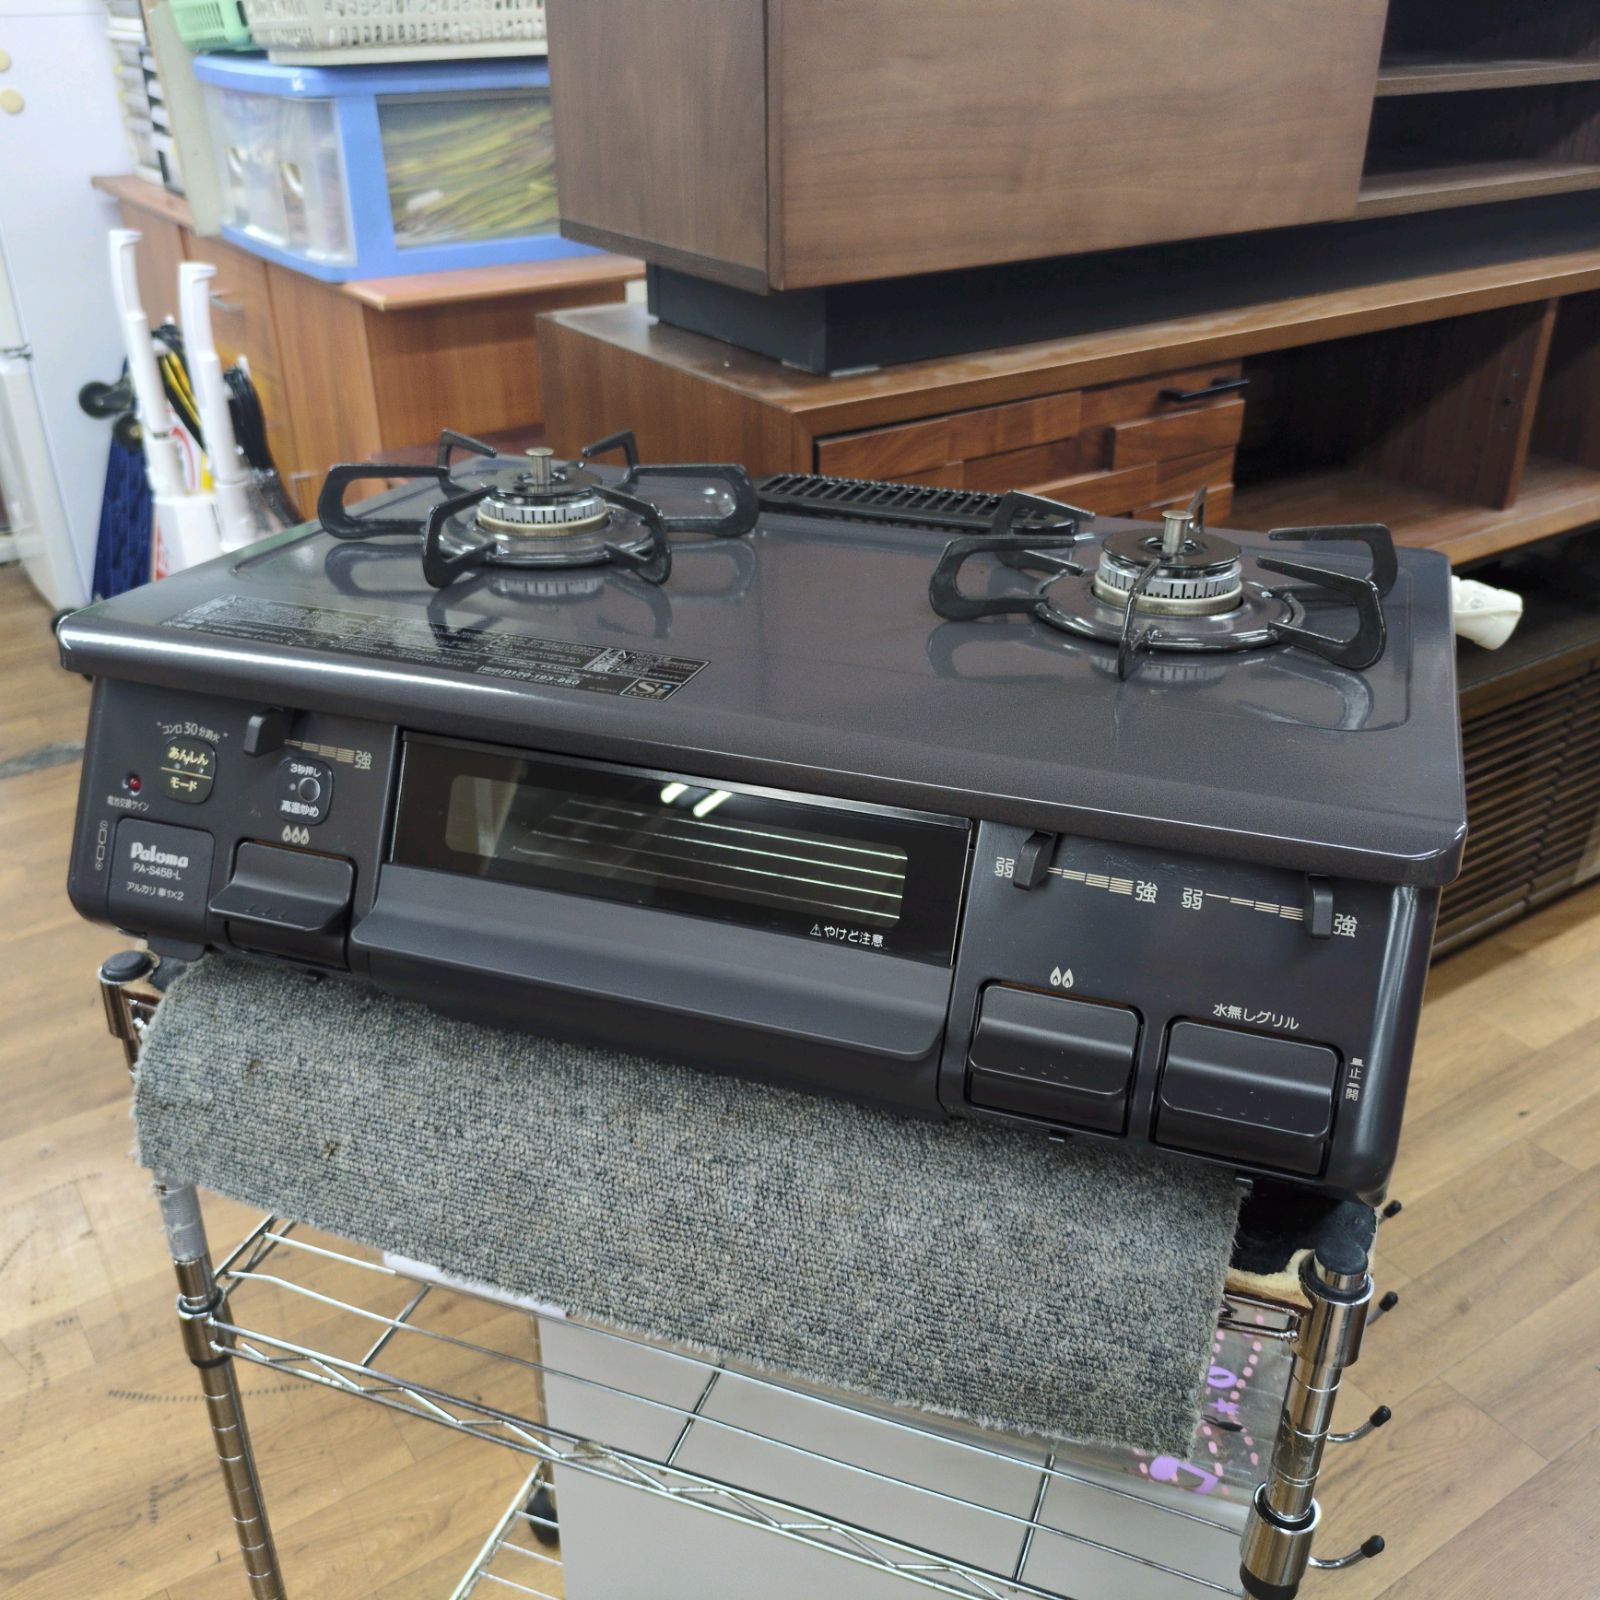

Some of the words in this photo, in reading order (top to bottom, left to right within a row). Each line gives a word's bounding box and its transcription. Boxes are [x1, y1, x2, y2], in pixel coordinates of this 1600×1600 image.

[168, 746, 209, 766] あんしん
[354, 750, 373, 770] 強
[170, 776, 198, 792] モード
[130, 842, 189, 868] Paloma
[994, 856, 1015, 879] 弱
[1135, 880, 1159, 904] 強
[1181, 887, 1203, 911] 弱
[1332, 913, 1358, 938] 強
[824, 925, 884, 948] やけど注意
[1212, 1002, 1300, 1031] 水無しグリル
[1349, 1067, 1362, 1080] 止
